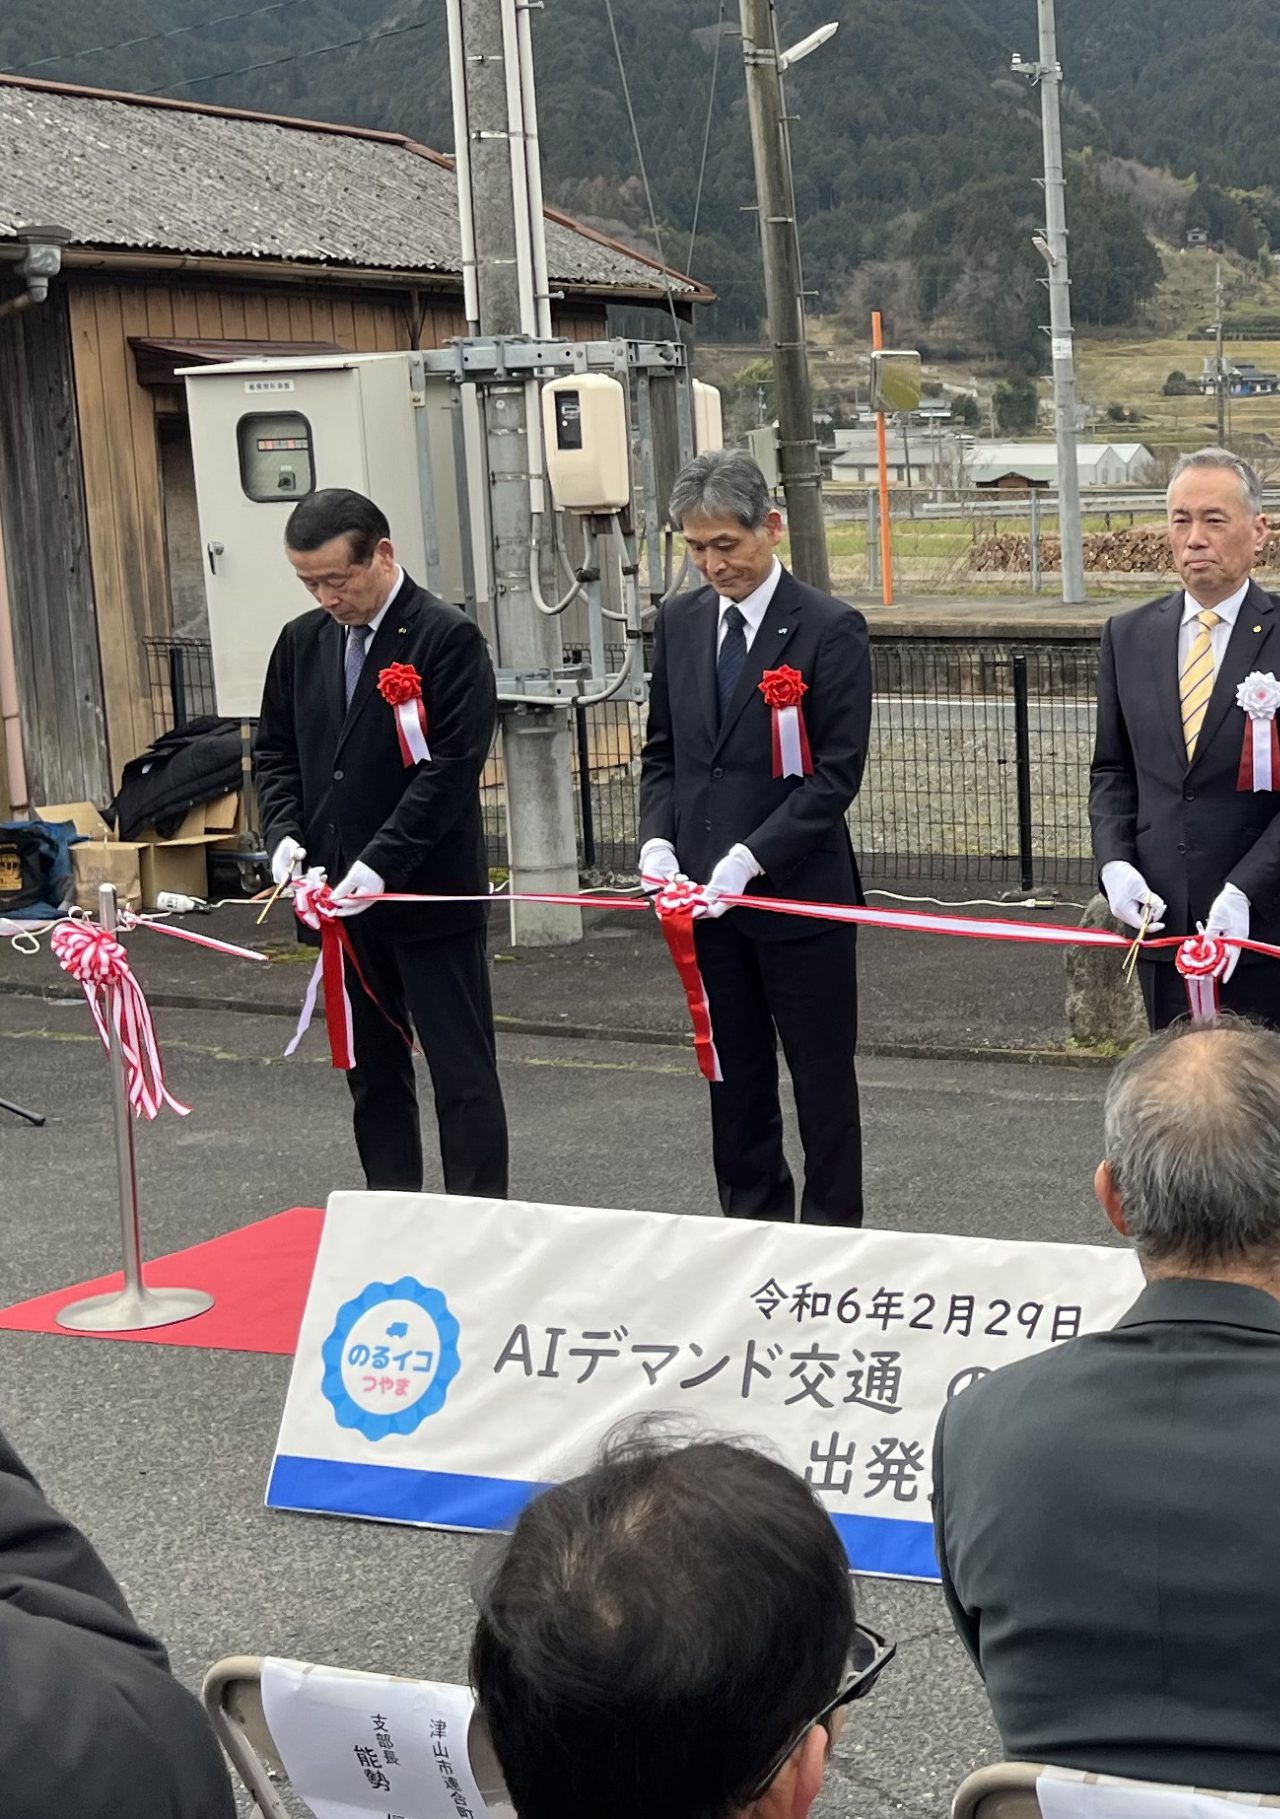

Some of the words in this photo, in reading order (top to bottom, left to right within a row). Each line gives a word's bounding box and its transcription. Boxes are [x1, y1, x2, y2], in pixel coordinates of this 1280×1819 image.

[750, 1277, 1083, 1342] 令和6年2月29日
[349, 1344, 433, 1373] のるイコ
[363, 1377, 411, 1395] つやま
[493, 1323, 904, 1415] AIデマンド交通
[804, 1431, 934, 1502] 出発
[371, 1714, 400, 1766] 支部長
